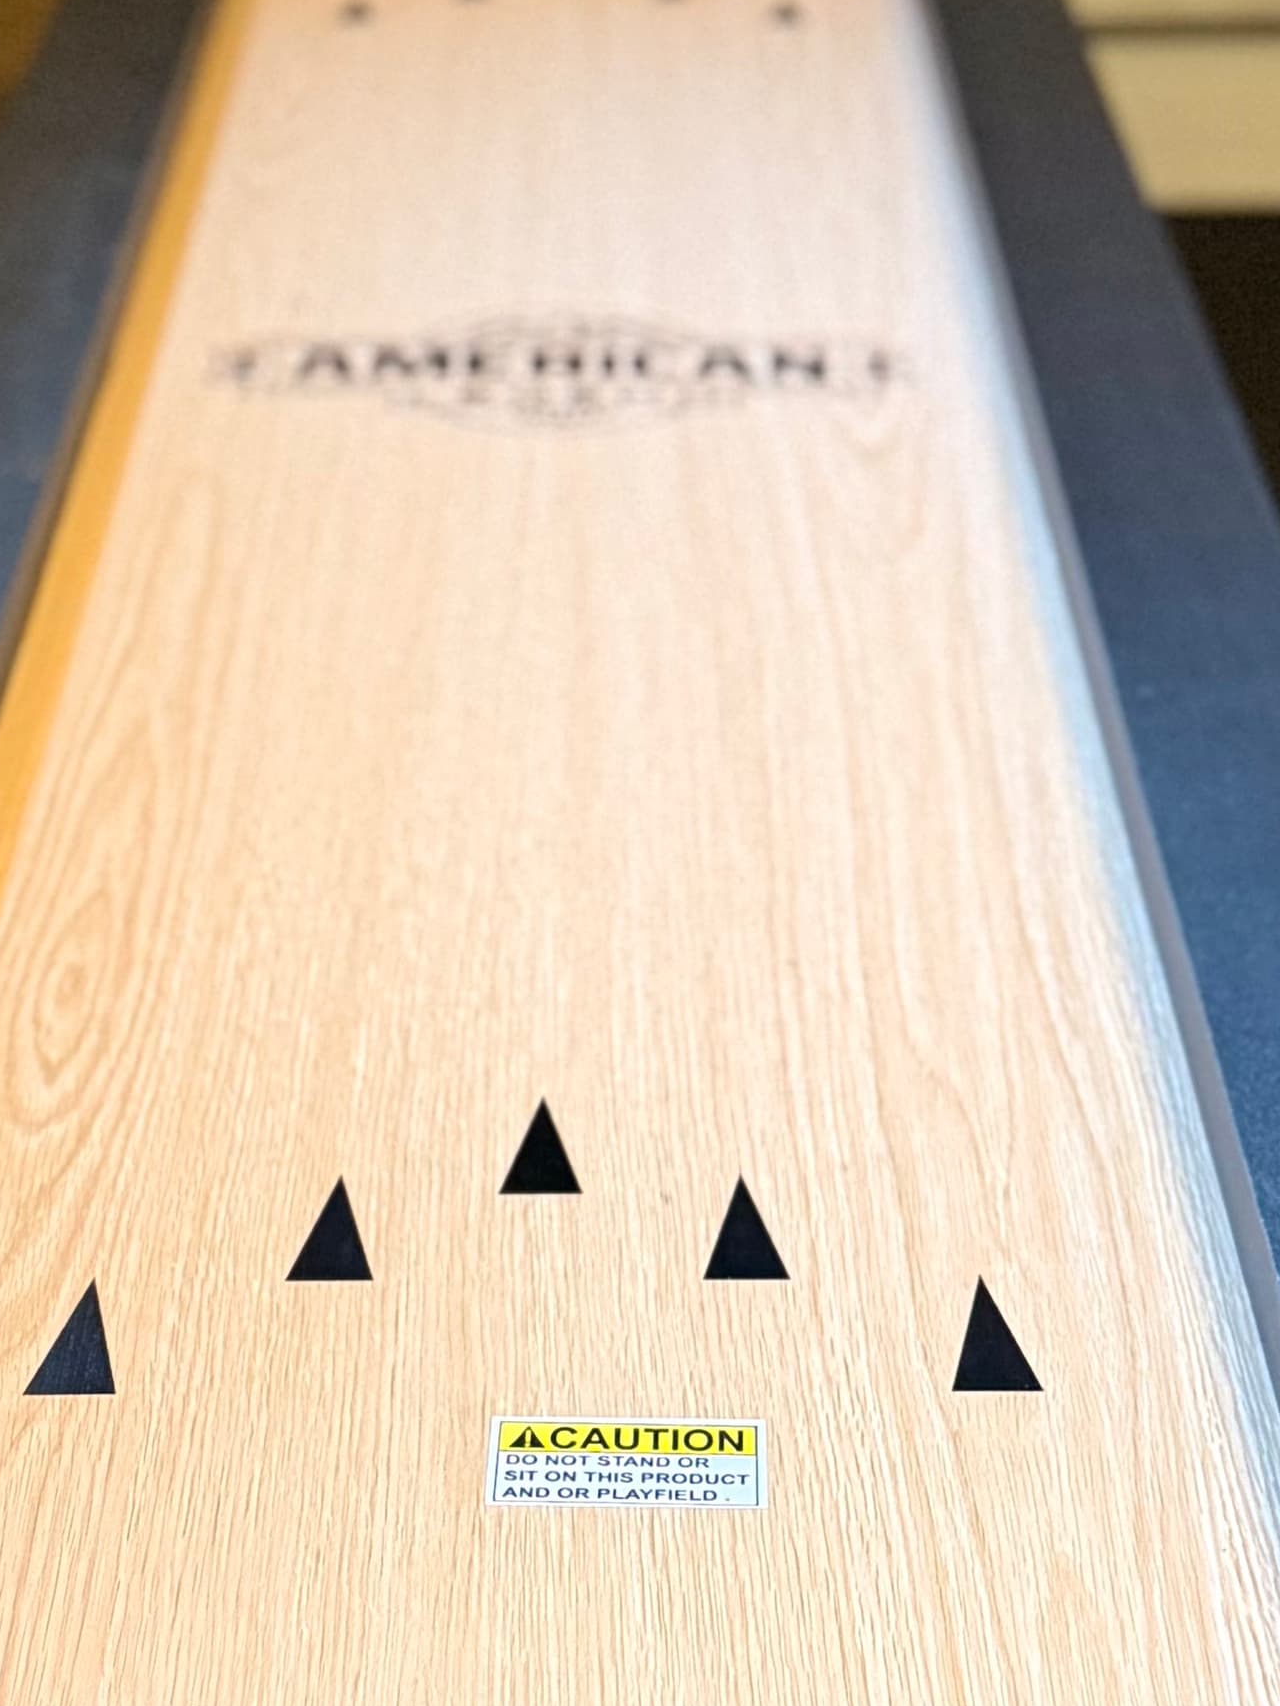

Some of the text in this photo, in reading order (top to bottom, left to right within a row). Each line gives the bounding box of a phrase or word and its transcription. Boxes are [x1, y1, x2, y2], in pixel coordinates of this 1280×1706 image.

[550, 1426, 744, 1452] CAUTION
[505, 1454, 710, 1469] DO NOT STAND OR
[504, 1470, 751, 1486] SIT ON THIS PRODUCT
[502, 1486, 550, 1499] AND
[557, 1487, 590, 1500] OR
